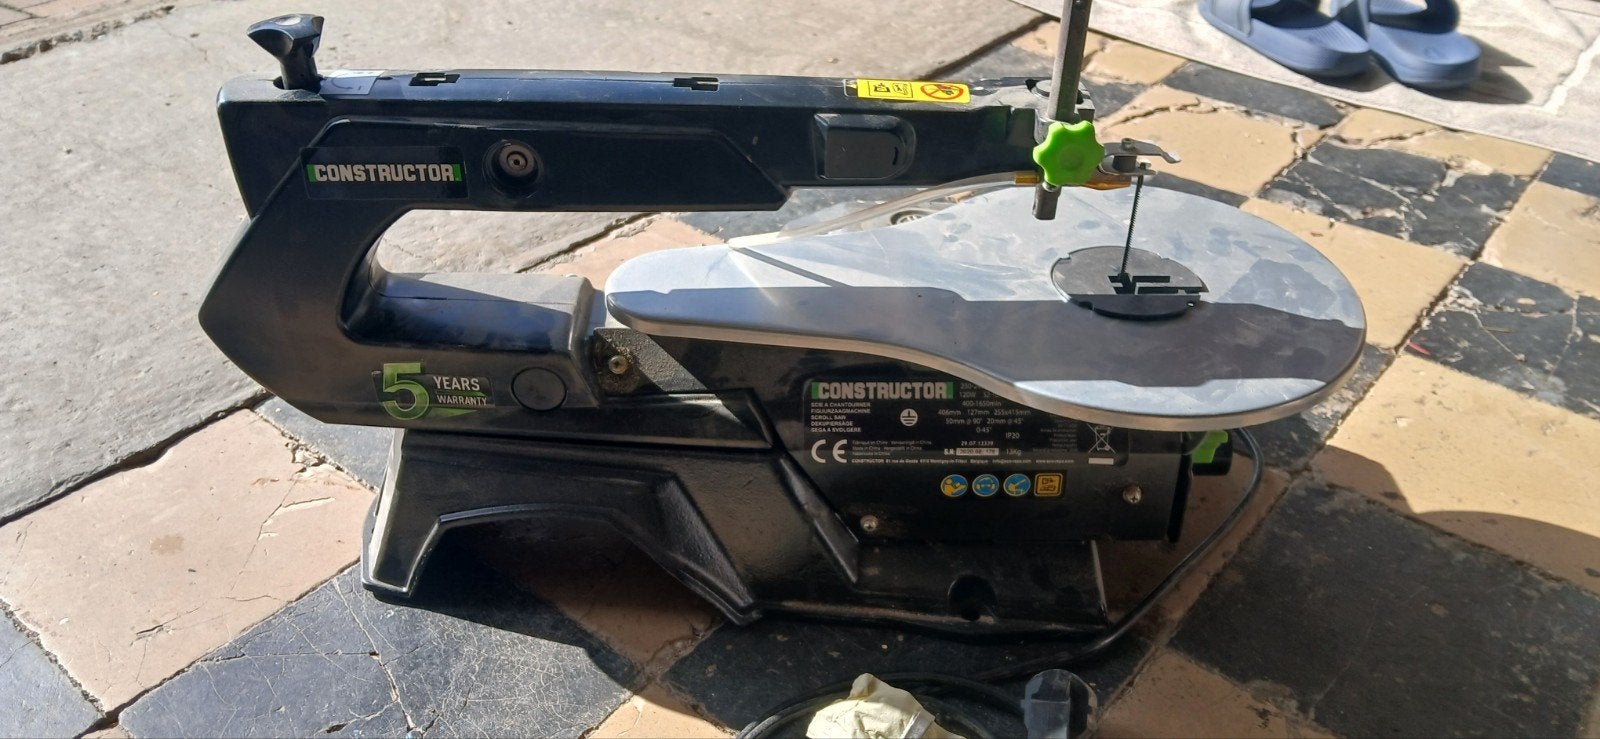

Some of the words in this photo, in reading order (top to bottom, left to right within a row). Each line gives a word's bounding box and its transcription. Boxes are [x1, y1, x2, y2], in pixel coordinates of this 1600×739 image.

[314, 163, 455, 182] CONSTRUCTOR
[382, 362, 430, 420] 5
[433, 375, 480, 391] YEARS
[818, 381, 948, 400] CONSTRUCTOR
[436, 394, 488, 406] WARRANTY
[811, 439, 848, 464] CE
